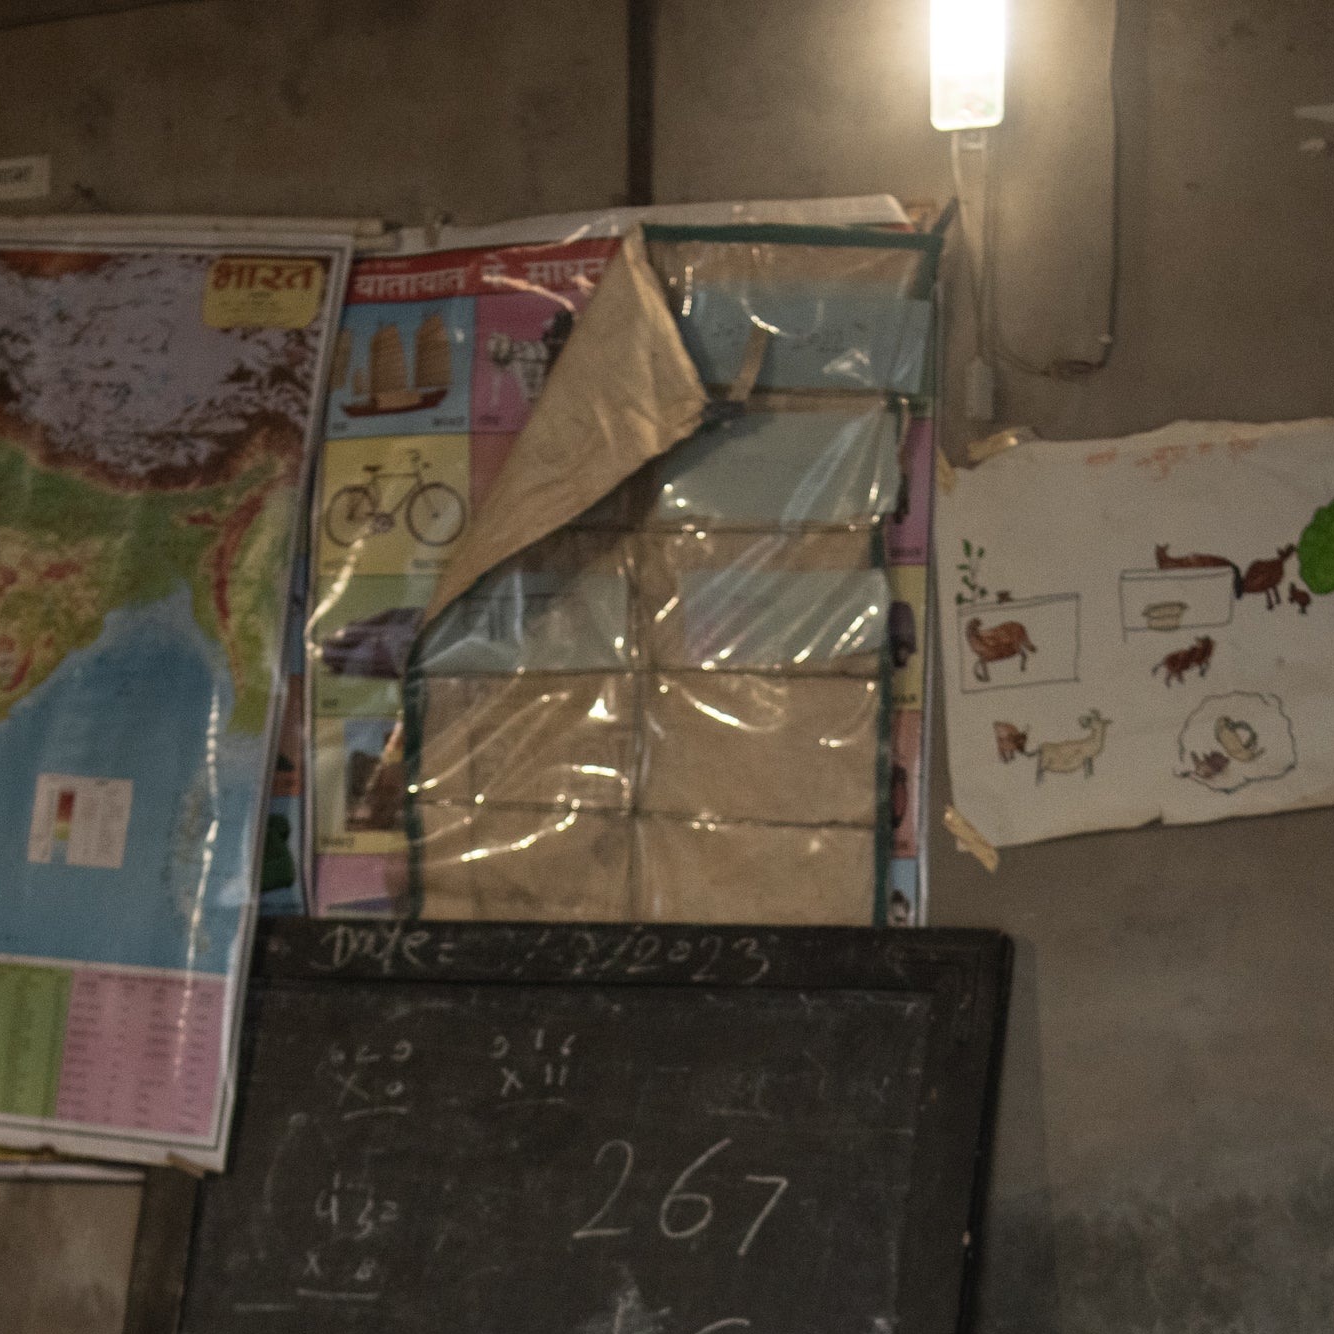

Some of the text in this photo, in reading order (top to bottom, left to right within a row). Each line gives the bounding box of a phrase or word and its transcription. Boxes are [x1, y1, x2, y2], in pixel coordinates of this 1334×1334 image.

[212, 262, 315, 290] भारत
[352, 266, 467, 298] यातायात
[573, 1137, 789, 1256] 267
